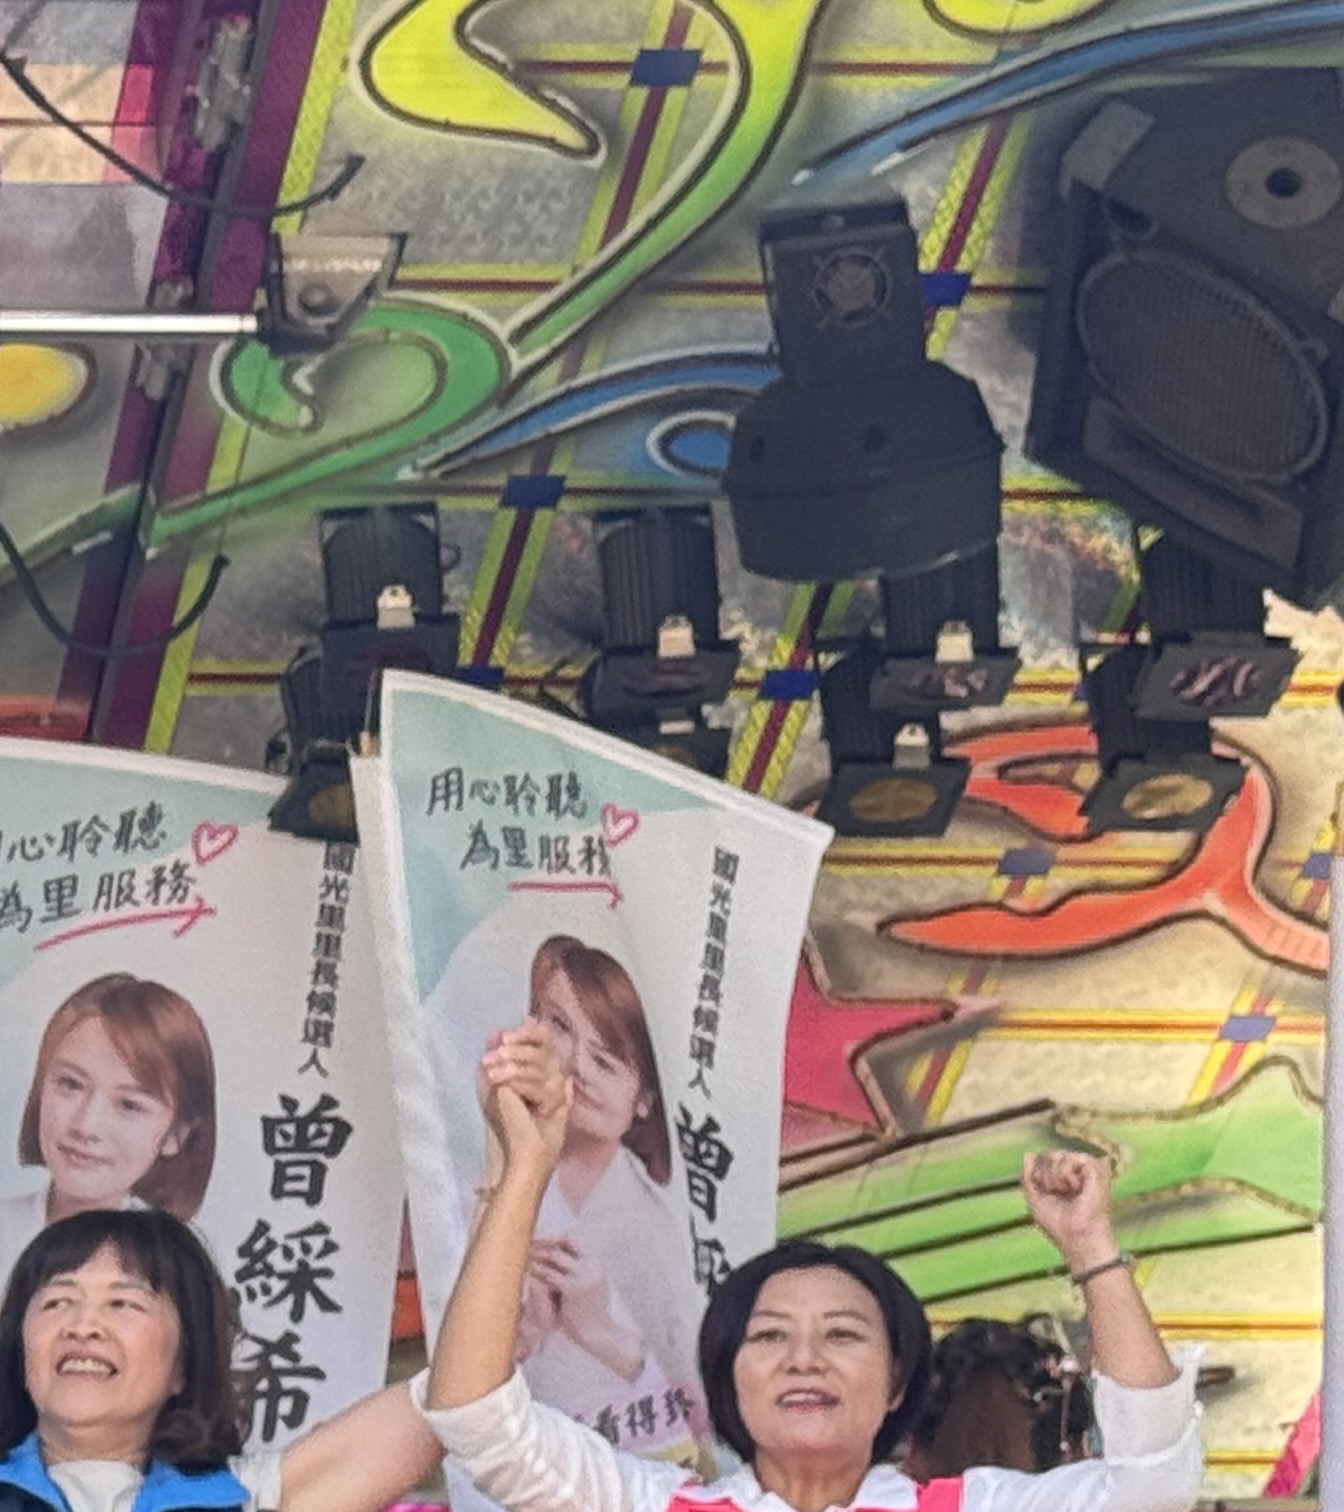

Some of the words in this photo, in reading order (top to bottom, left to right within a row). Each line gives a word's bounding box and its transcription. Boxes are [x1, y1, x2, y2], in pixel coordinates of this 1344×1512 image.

[426, 766, 589, 820] 用心聆聽
[228, 1093, 354, 1443] 曾綵希
